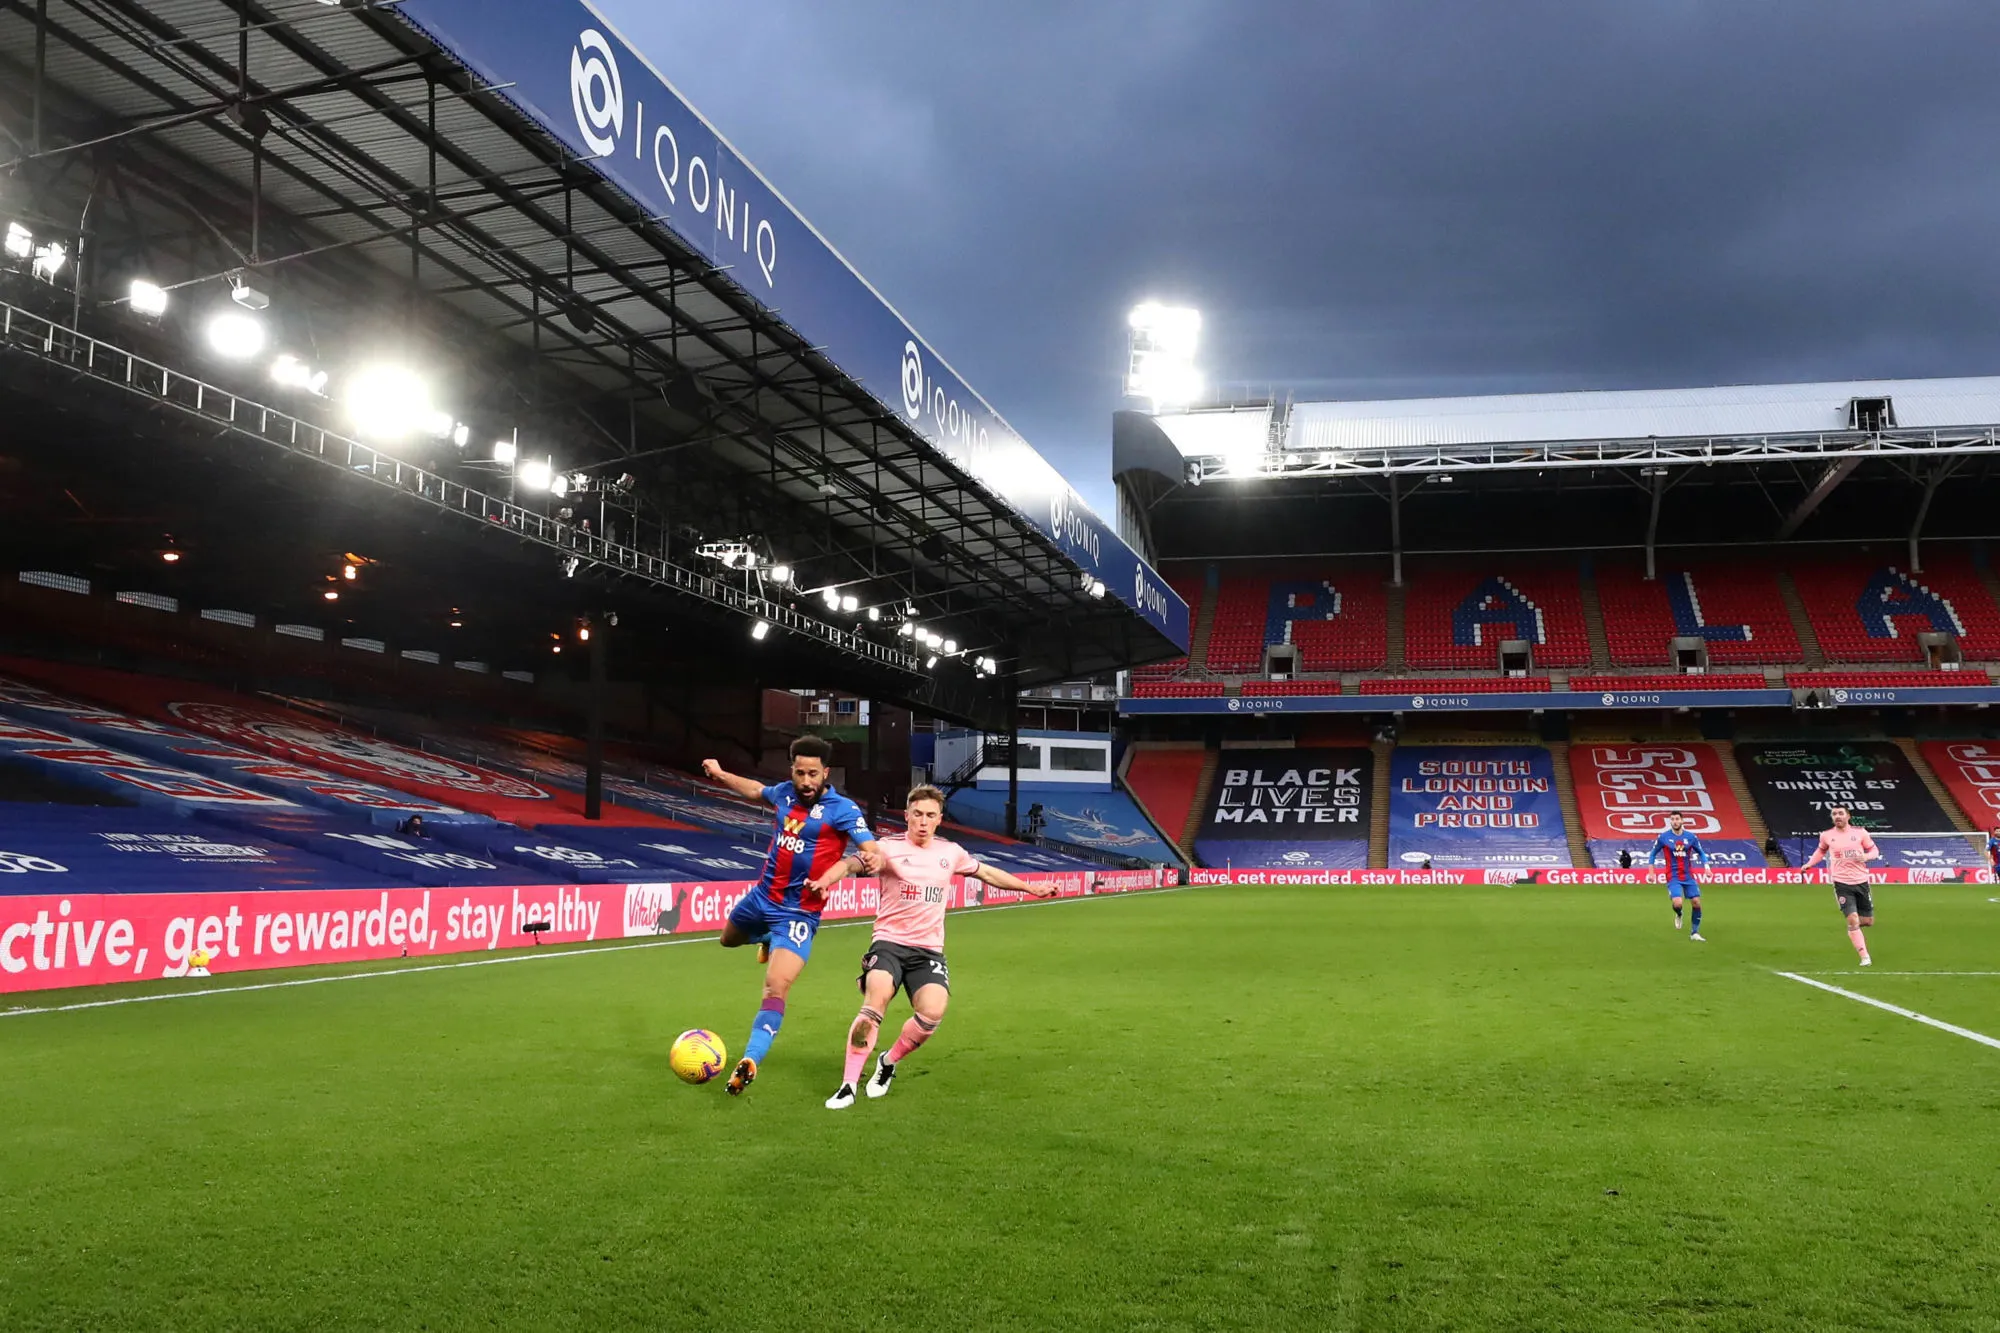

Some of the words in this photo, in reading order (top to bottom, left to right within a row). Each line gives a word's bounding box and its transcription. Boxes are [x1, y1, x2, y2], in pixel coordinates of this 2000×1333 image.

[635, 100, 776, 289] IQONIQ
[1064, 512, 1100, 568] IQONIQ
[1143, 586, 1168, 624] IQONIQ
[1426, 697, 1469, 708] IQONIQ
[1616, 694, 1660, 705] IQONIQ
[1850, 691, 1896, 702] IQONIQ
[1241, 700, 1284, 710] IQONIQ
[1418, 760, 1531, 776] SOUTH
[1801, 770, 1855, 780] TEXT
[1224, 768, 1362, 787] BLACK
[1401, 778, 1549, 793] LONDON
[1219, 786, 1360, 808] LIVES
[1436, 795, 1513, 811] AND
[1825, 790, 1856, 800] TO
[1213, 808, 1360, 824] MATTER
[1414, 813, 1540, 828] PROUD
[776, 832, 805, 854] W88
[1238, 871, 1266, 885] get
[1270, 869, 1357, 885] rewarded,
[1361, 869, 1396, 885] stay
[1401, 869, 1465, 885] healthy
[1546, 869, 1578, 885] Get
[1582, 868, 1640, 885] active,
[1693, 870, 1772, 885] warded,
[1776, 870, 1814, 885] stay
[690, 885, 721, 923] Get
[823, 879, 859, 914] arded,
[861, 883, 881, 916] stay
[0, 899, 149, 974] ctive,
[162, 905, 243, 978] get
[253, 891, 438, 956] rewarded,
[445, 897, 504, 950] stay
[511, 887, 602, 941] healthy
[788, 920, 810, 942] 10
